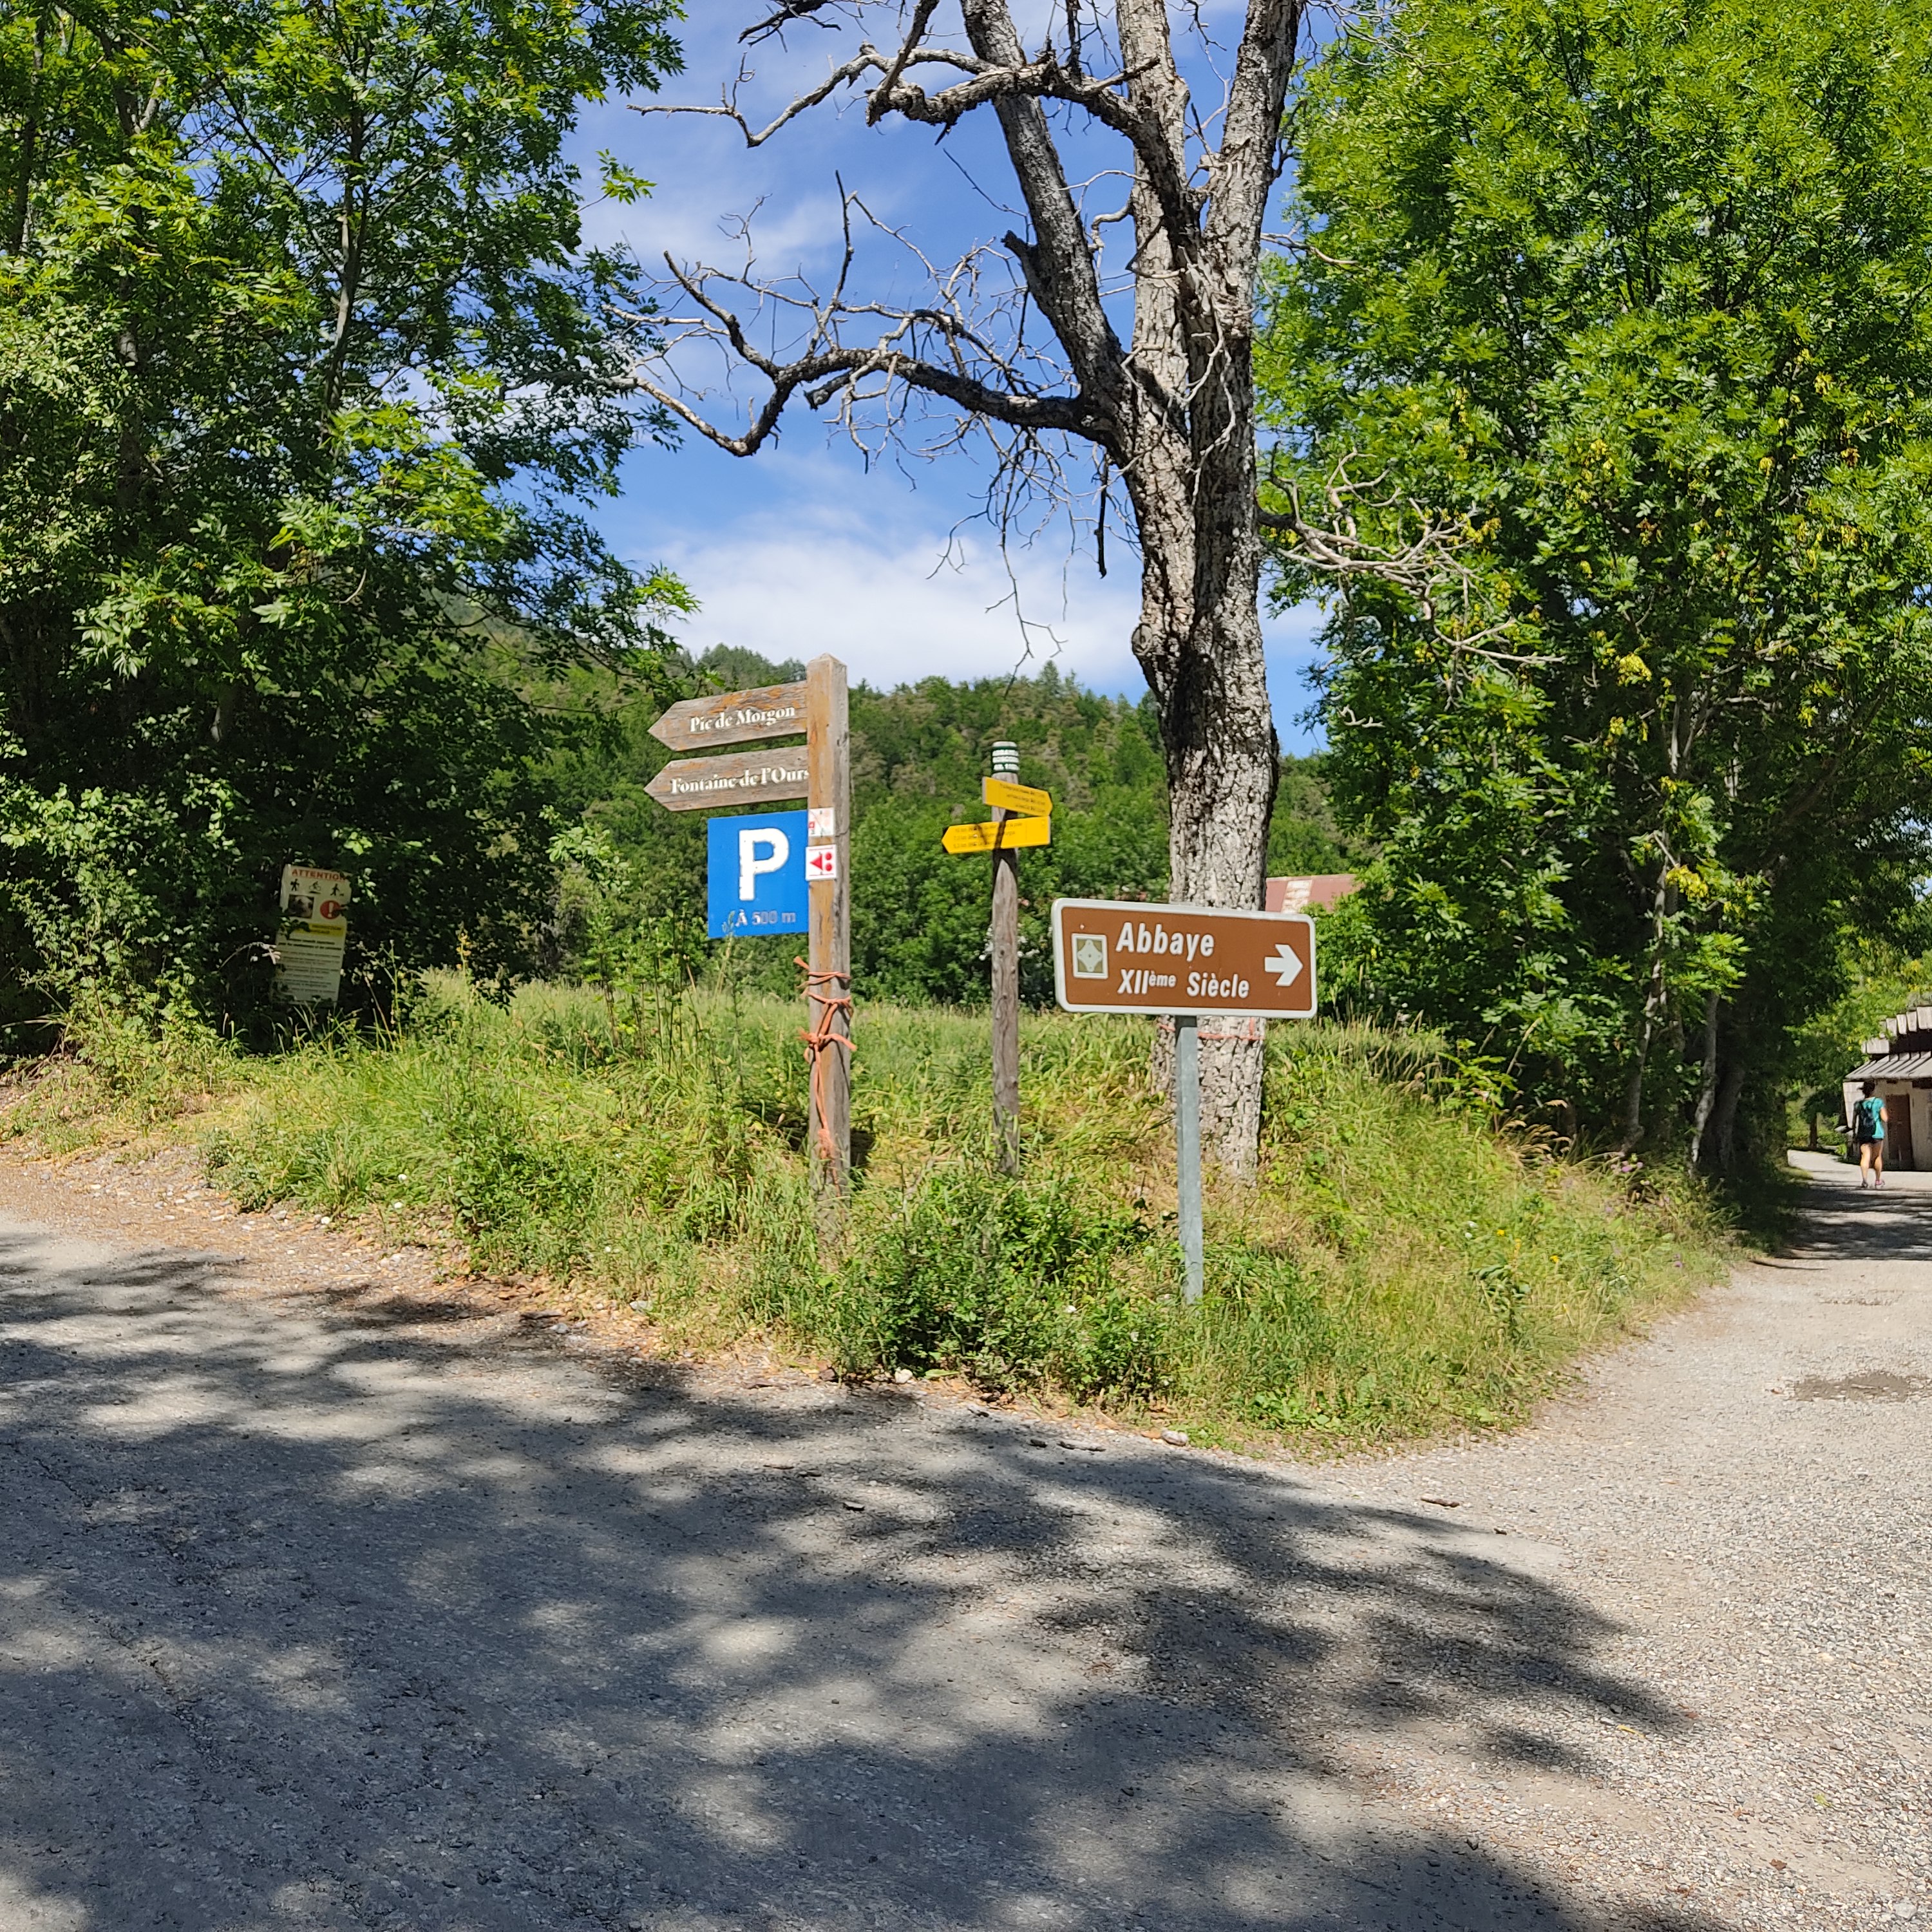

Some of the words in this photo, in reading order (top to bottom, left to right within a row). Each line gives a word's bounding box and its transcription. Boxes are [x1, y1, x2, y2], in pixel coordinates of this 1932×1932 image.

[690, 716, 710, 732] Pic
[715, 712, 733, 728] de
[736, 706, 795, 726] Morgon
[670, 774, 737, 794] Fontaine
[739, 768, 758, 787] de
[739, 828, 790, 901] P
[752, 910, 778, 925] 500
[781, 912, 796, 923] m
[1115, 922, 1215, 962] Abbaye
[1117, 969, 1177, 995] XIIème
[1186, 971, 1250, 999] Siècle
